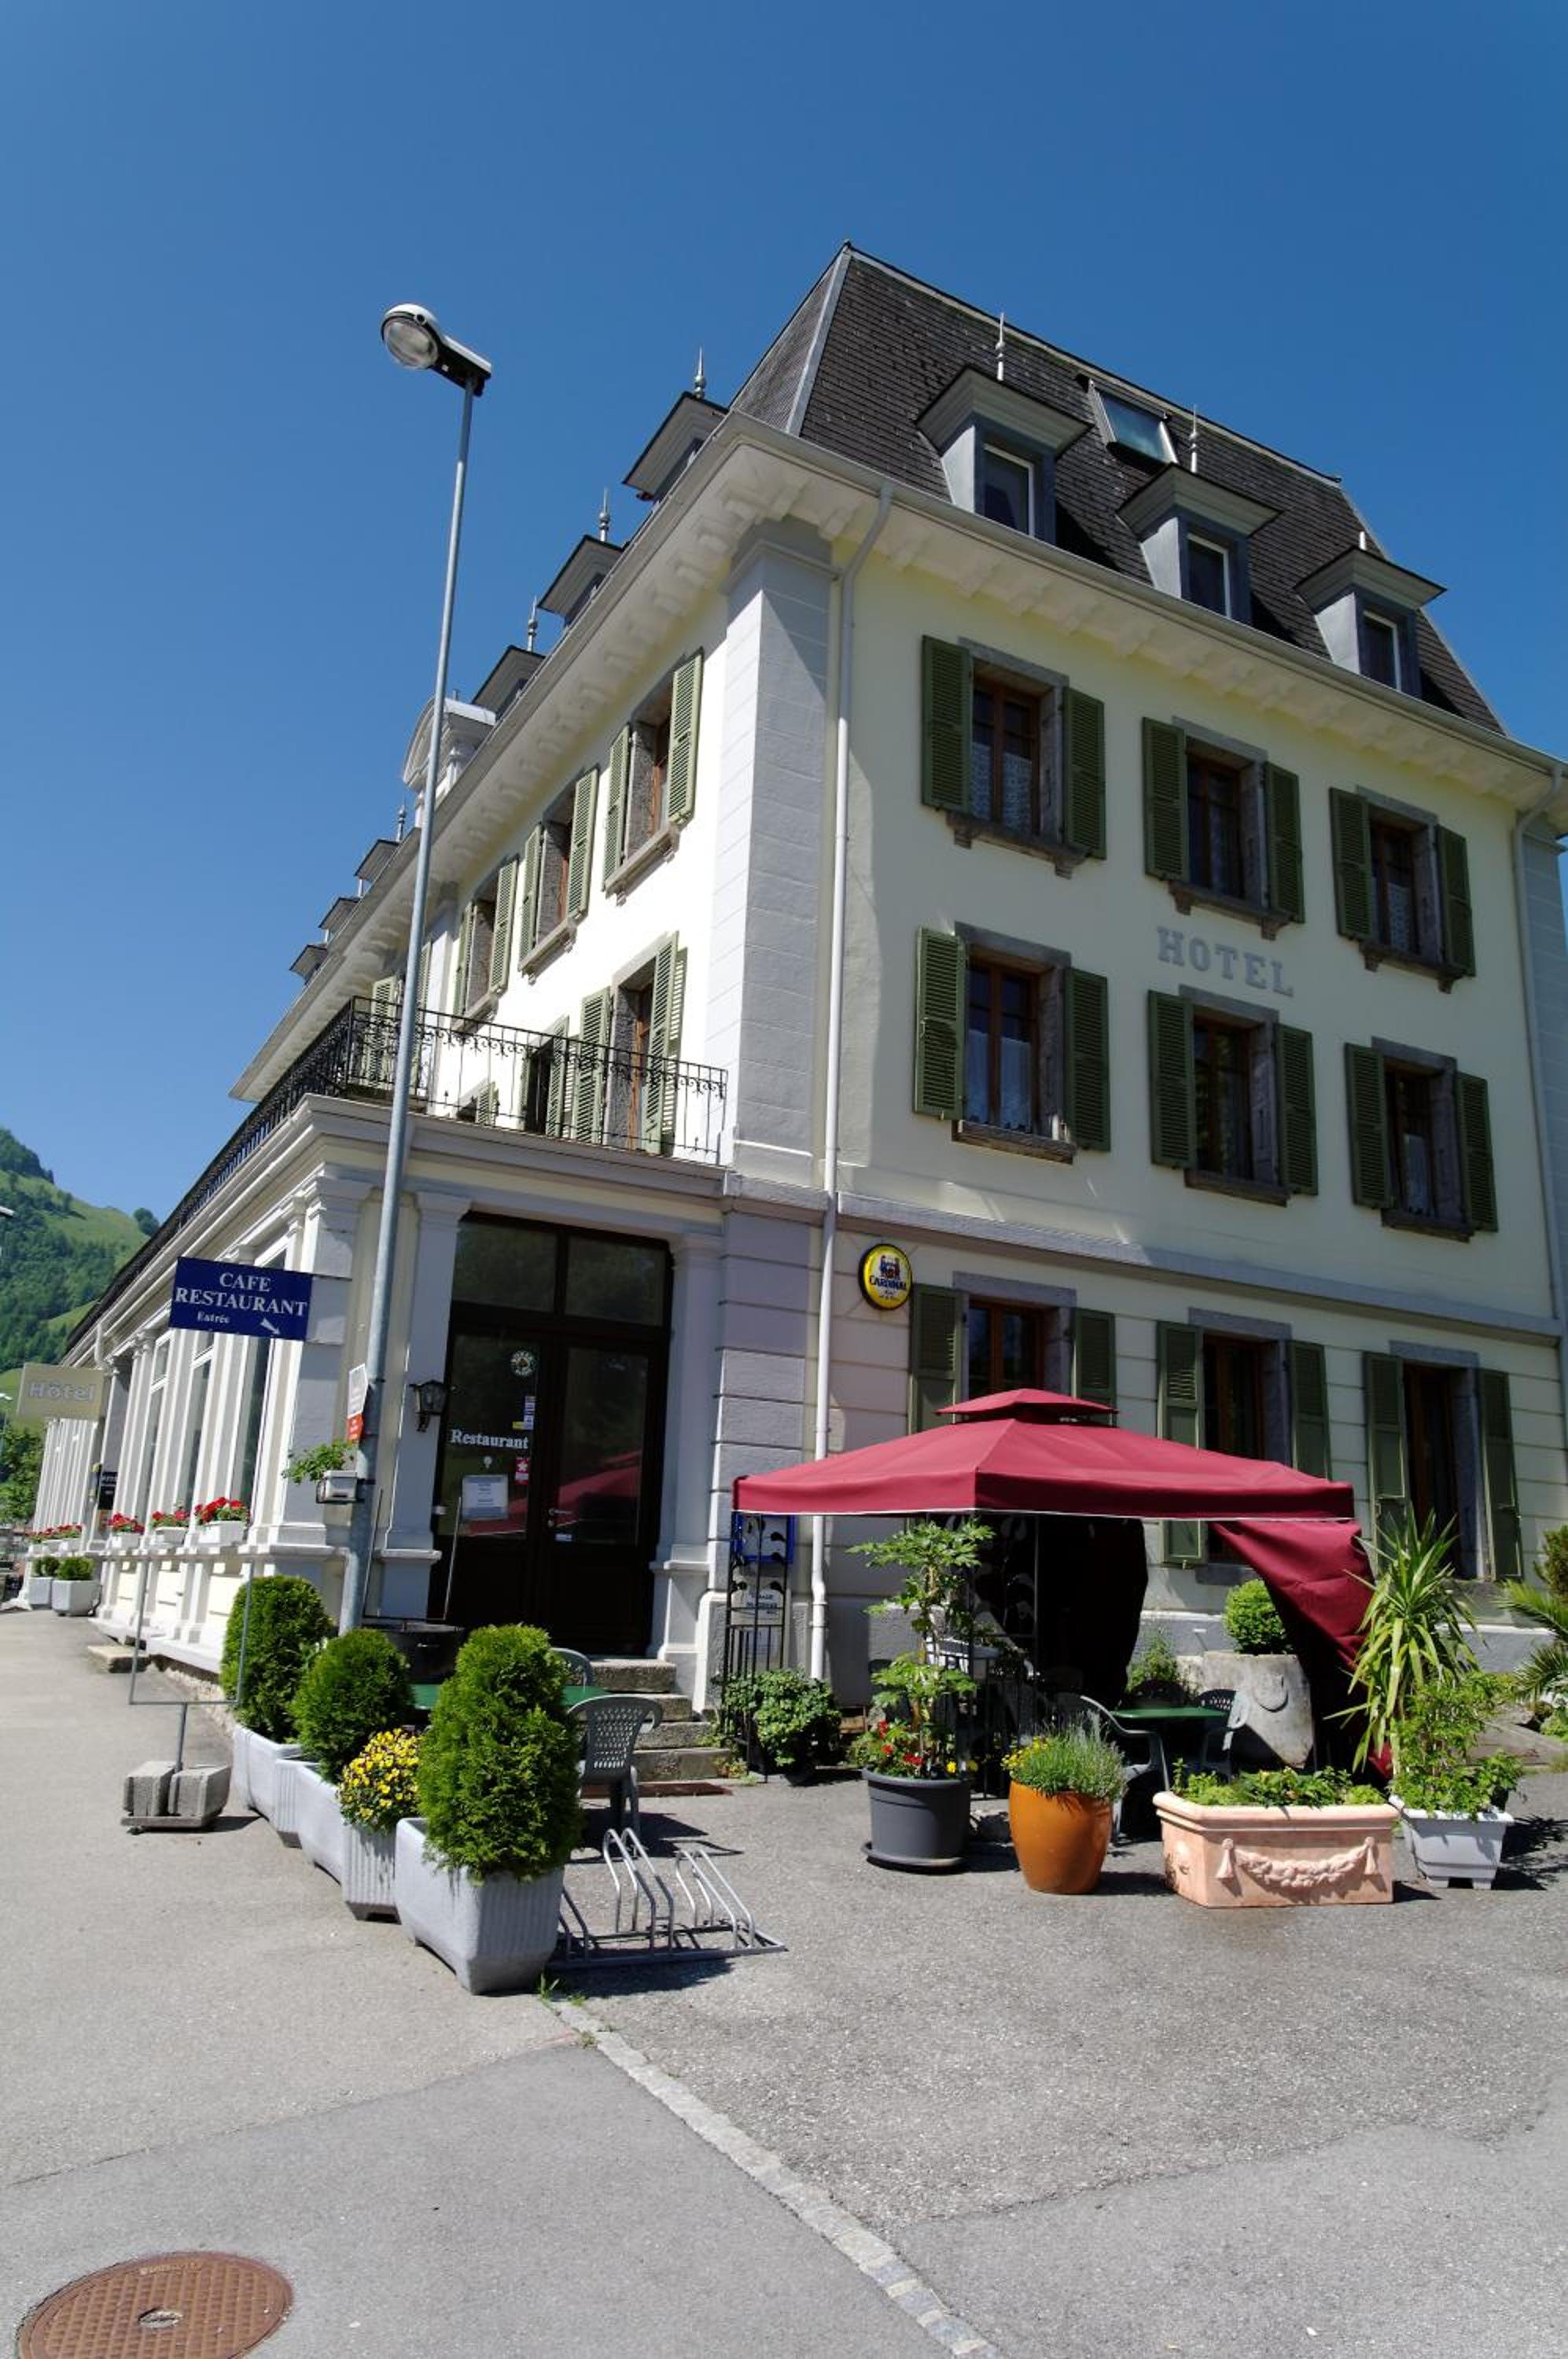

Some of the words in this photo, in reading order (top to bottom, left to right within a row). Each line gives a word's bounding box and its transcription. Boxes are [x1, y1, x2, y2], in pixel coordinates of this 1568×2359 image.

[1157, 926, 1294, 998] HOTEL
[219, 1272, 271, 1292] CAFE
[175, 1287, 307, 1316] RESTAURANT
[451, 1429, 528, 1449] Restaurant
